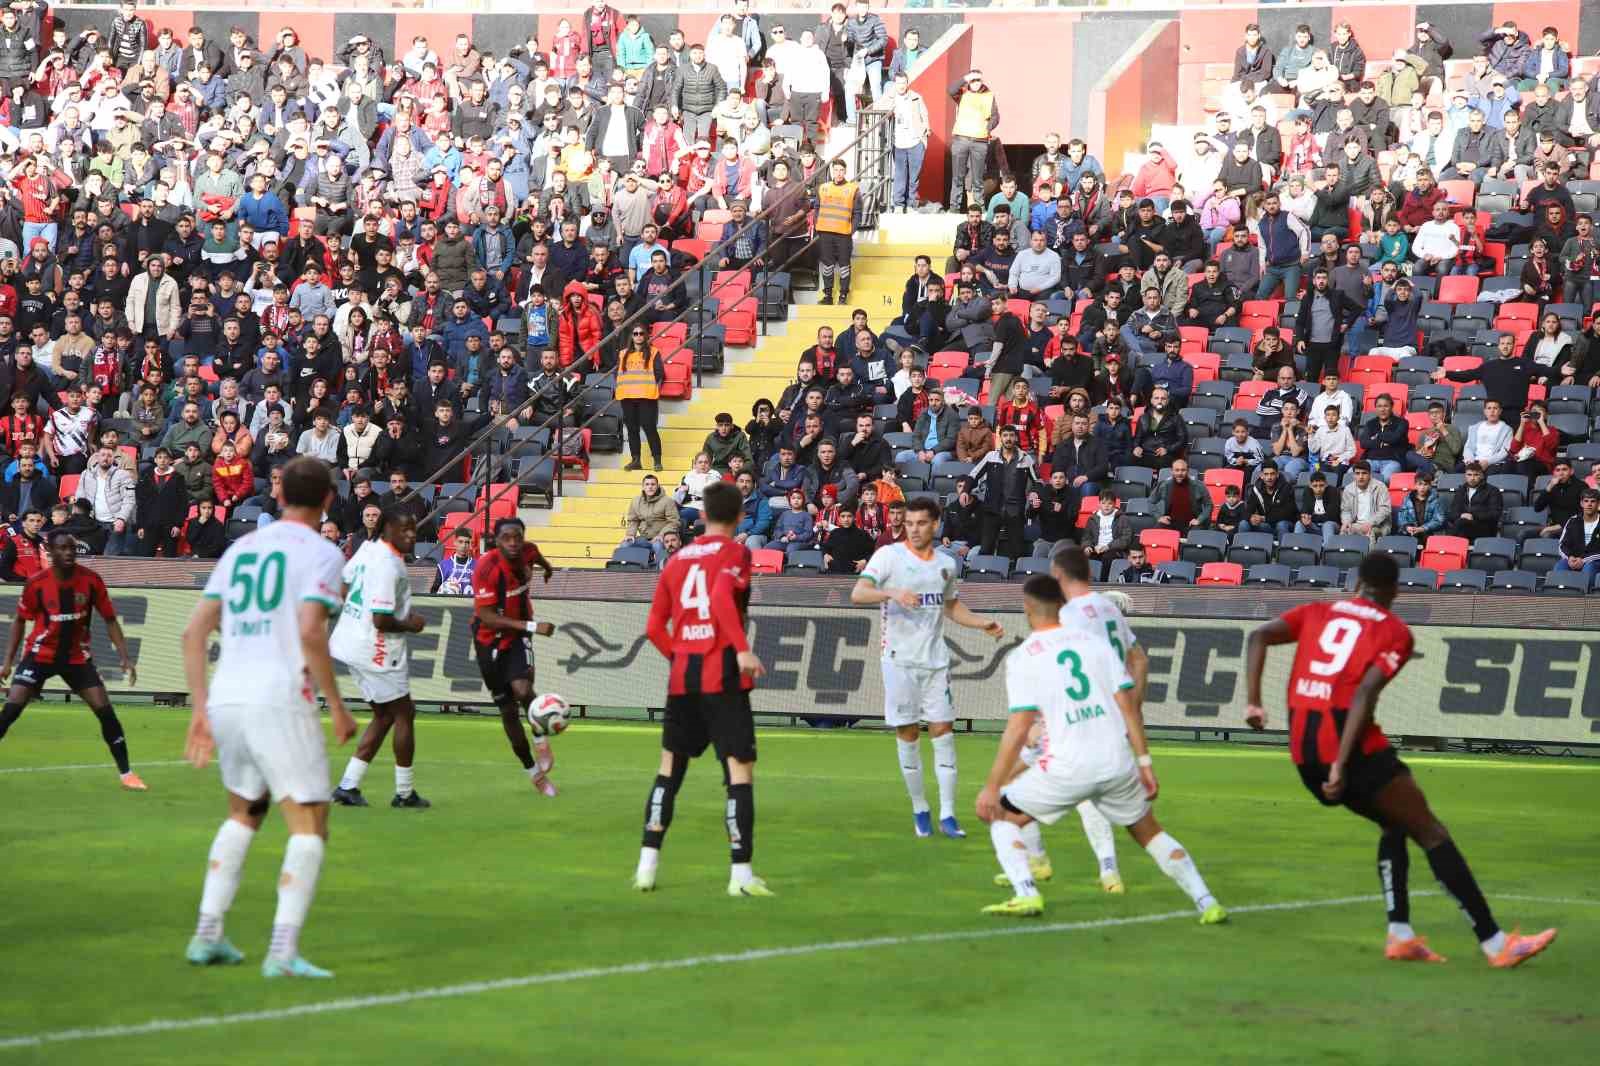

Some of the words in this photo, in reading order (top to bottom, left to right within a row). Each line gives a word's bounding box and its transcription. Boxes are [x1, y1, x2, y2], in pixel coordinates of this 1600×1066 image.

[883, 295, 892, 306] 14
[585, 545, 591, 557] 5
[229, 551, 286, 614] 50
[680, 564, 711, 620] 4
[1105, 620, 1125, 663] 5
[1309, 617, 1362, 677] 9
[1056, 649, 1091, 701] 3
[1065, 704, 1106, 725] LIMA
